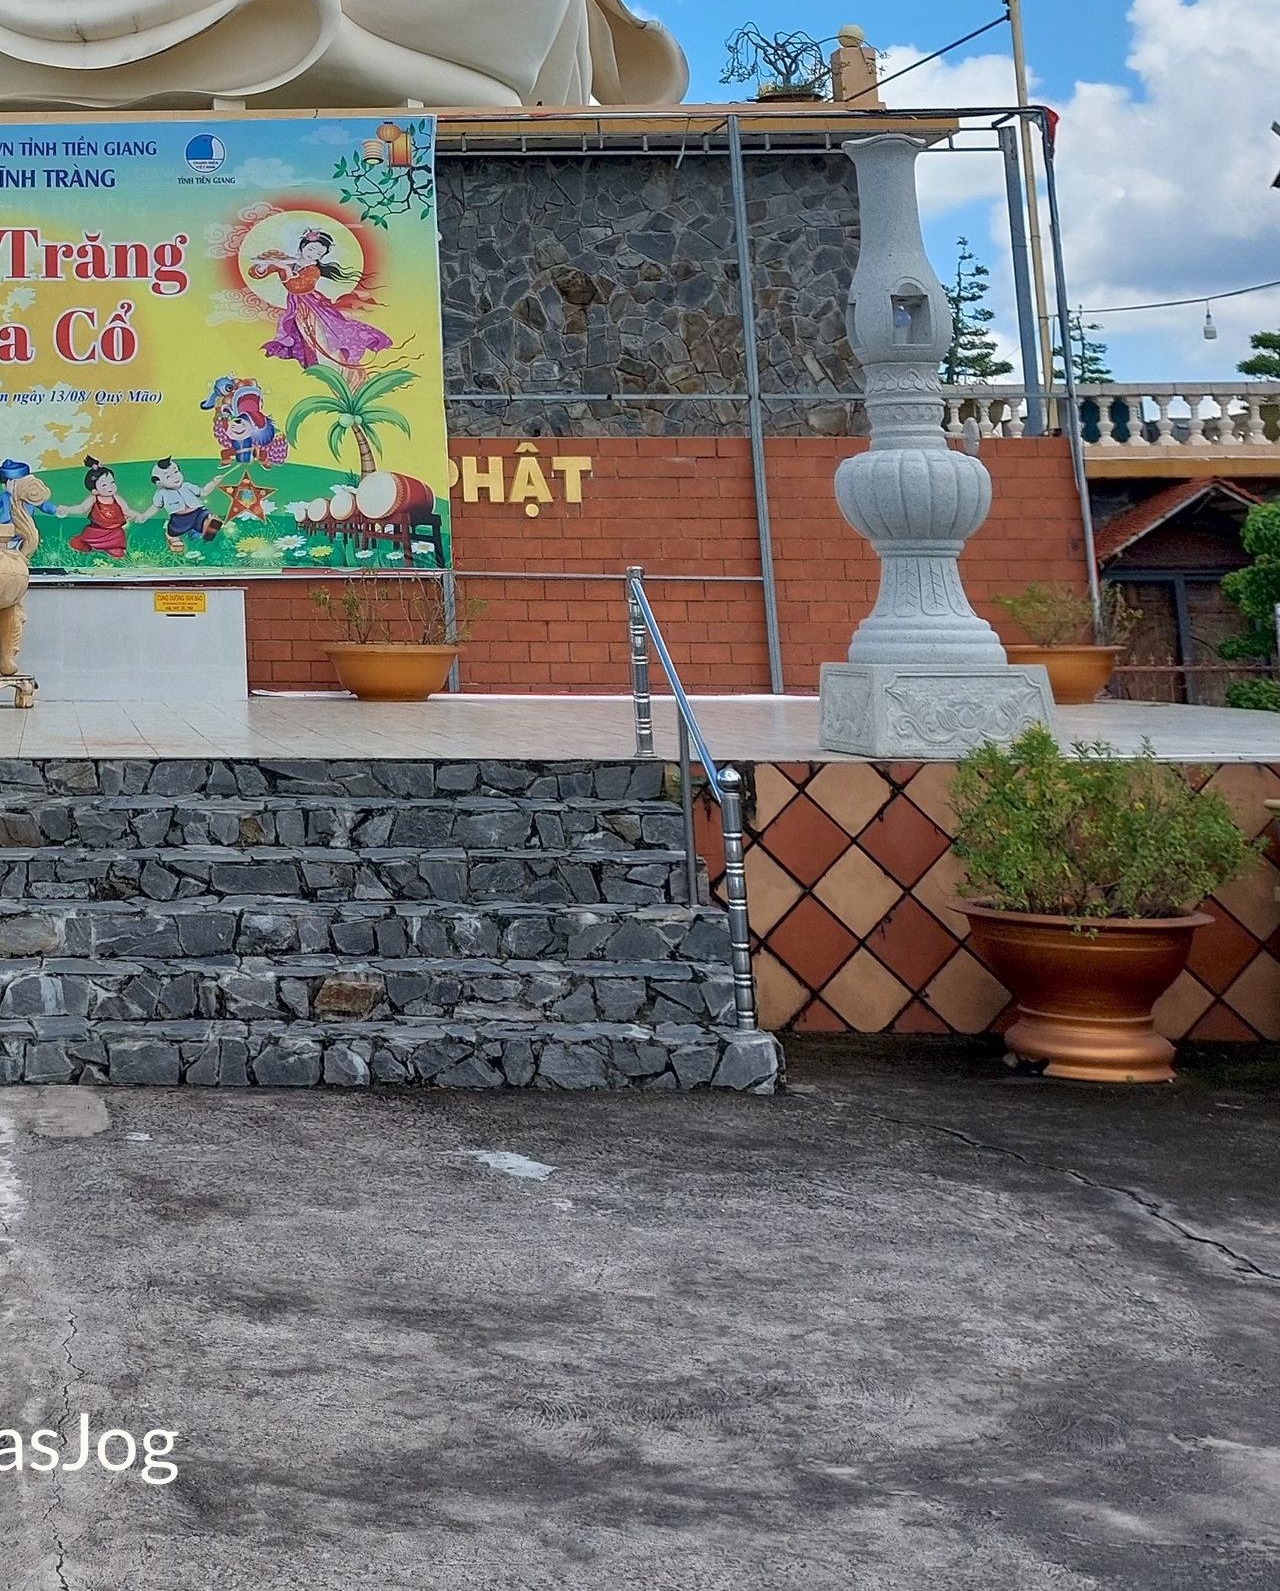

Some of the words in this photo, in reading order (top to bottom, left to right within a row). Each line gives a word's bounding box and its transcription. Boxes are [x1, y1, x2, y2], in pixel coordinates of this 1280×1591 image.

[19, 137, 57, 156] TỈNH
[62, 135, 98, 156] TIỀN
[104, 141, 157, 156] GIANG
[42, 163, 116, 188] TRÀNG
[56, 302, 136, 362] Cổ
[12, 390, 45, 405] ngày
[95, 390, 122, 405] Quý
[126, 390, 162, 404] Mão)
